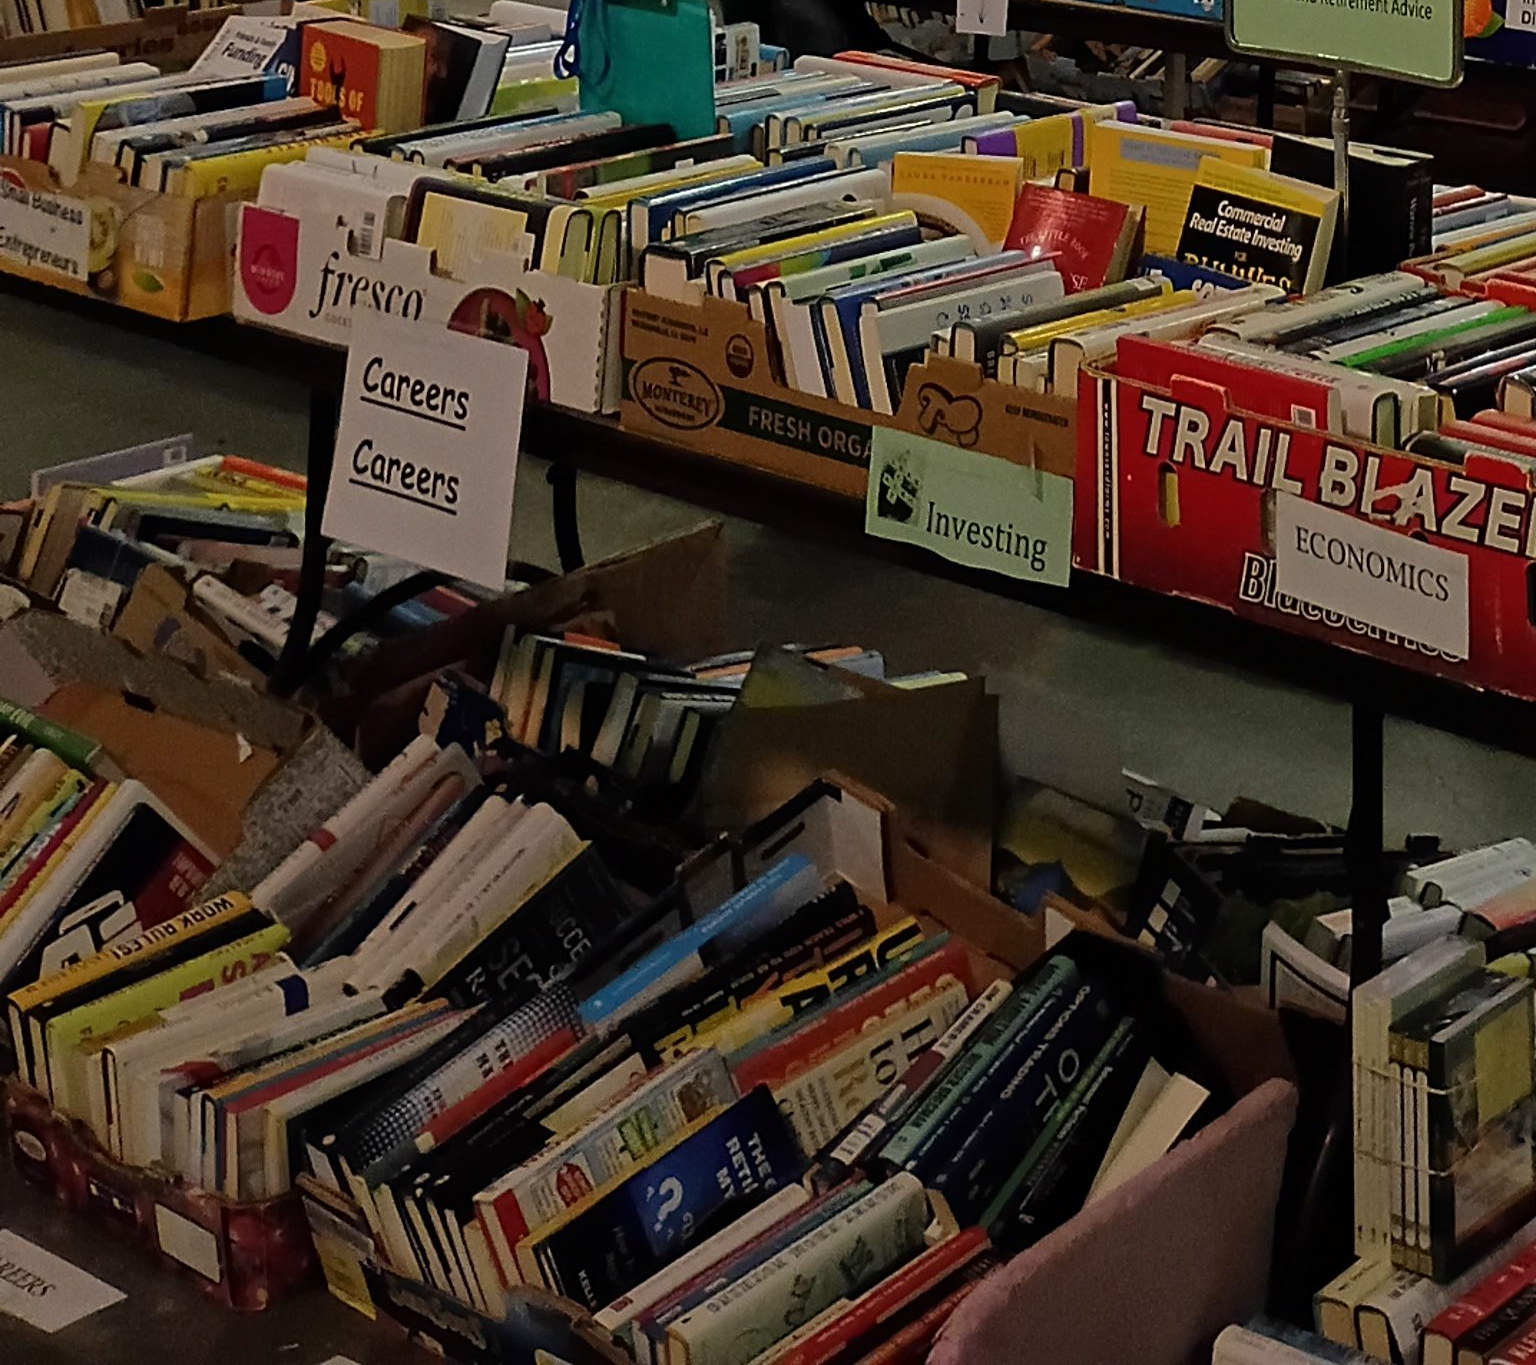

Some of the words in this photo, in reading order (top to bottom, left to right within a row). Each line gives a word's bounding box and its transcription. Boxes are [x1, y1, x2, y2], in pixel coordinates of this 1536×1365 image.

[223, 42, 269, 70] Funding
[1189, 212, 1215, 233] Real
[1215, 218, 1251, 244] Estate
[1251, 228, 1303, 261] Investing
[1217, 200, 1286, 232] Commercial
[362, 356, 470, 421] Careers
[641, 381, 714, 418] MONTEREY
[748, 406, 811, 443] FRESH
[1140, 396, 1302, 492] TRAIL
[352, 439, 460, 505] Careers
[927, 501, 1049, 572] Investing
[1295, 526, 1451, 603] ECONOMICS
[171, 895, 234, 932] WORK
